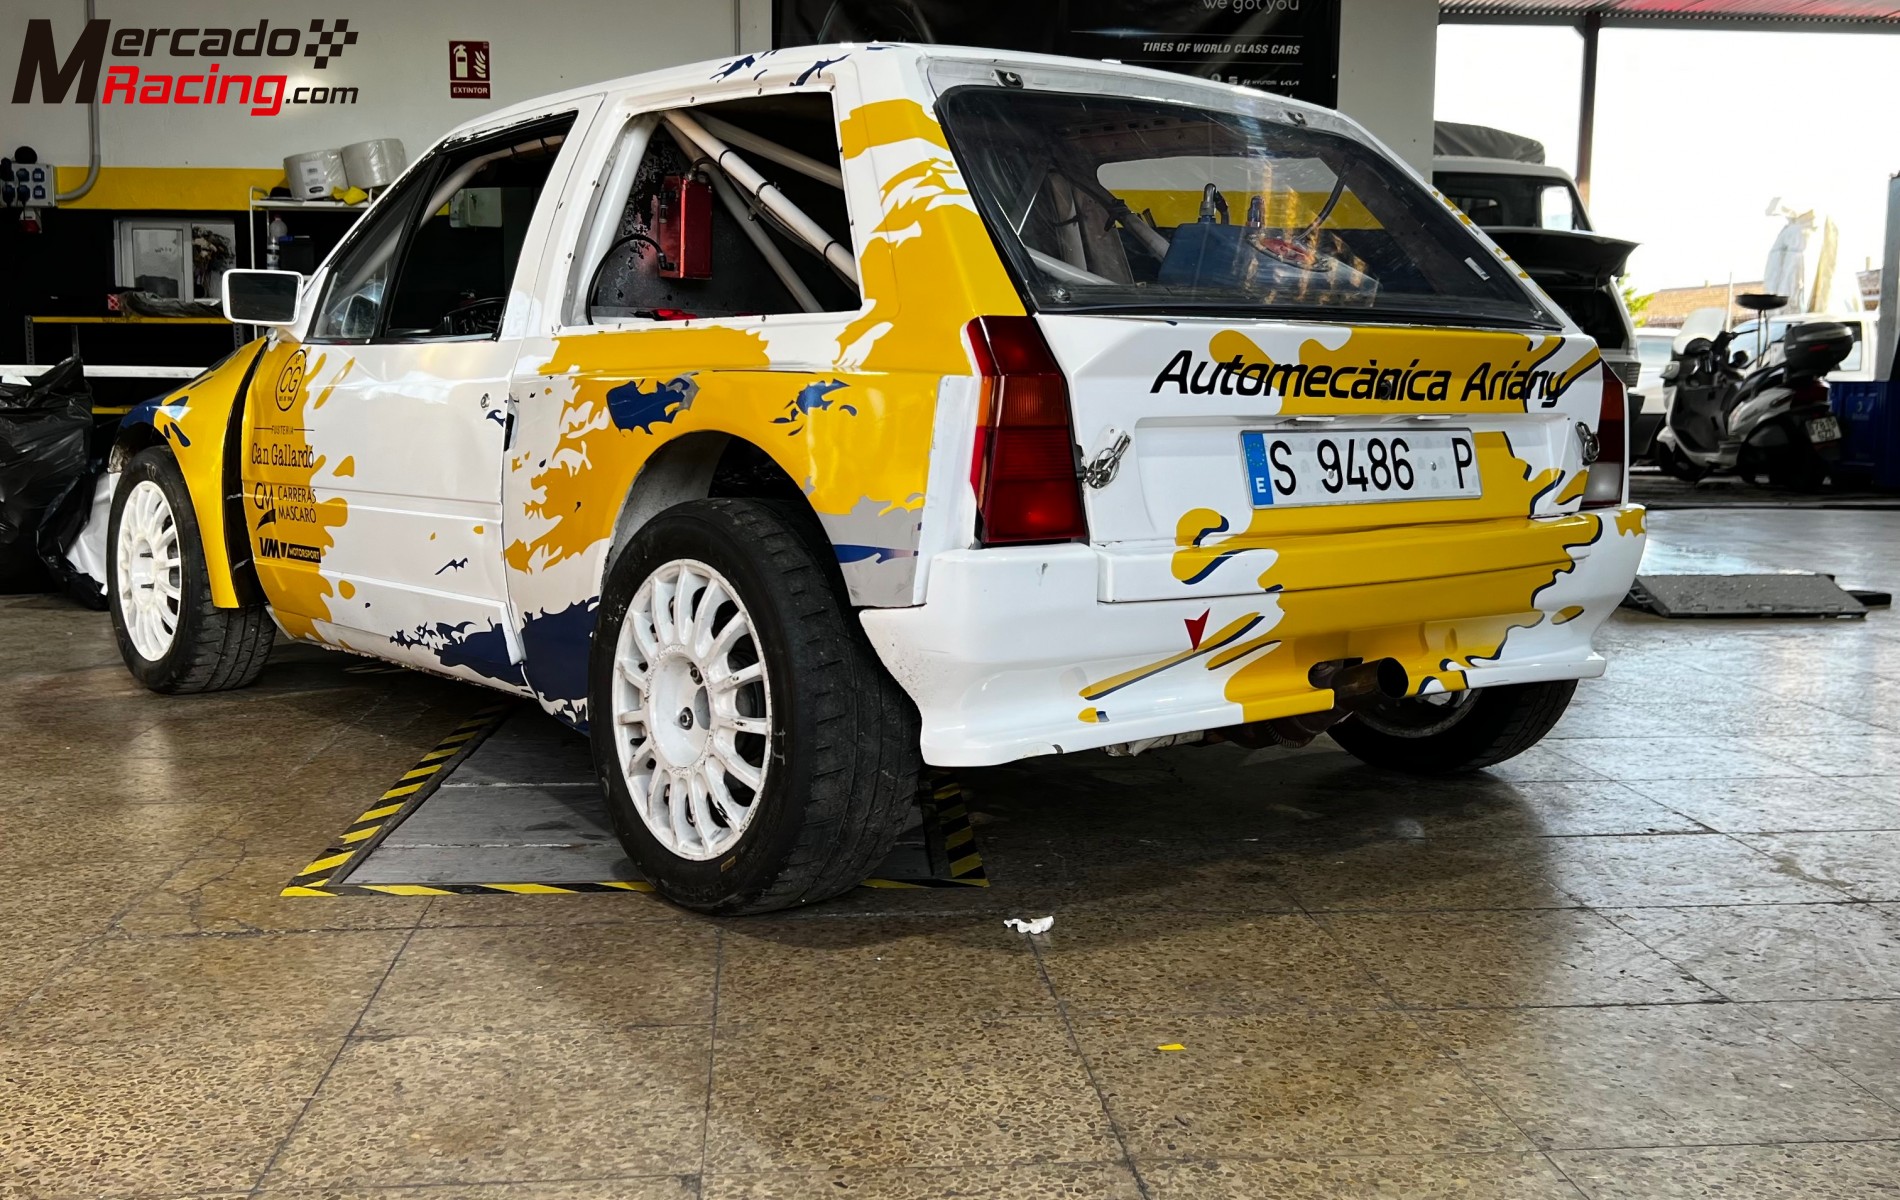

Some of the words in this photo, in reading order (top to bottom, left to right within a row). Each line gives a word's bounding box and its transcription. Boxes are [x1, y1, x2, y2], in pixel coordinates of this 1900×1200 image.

[1203, 0, 1227, 9] we
[1233, 0, 1262, 14] got
[1266, 0, 1299, 14] you
[1143, 42, 1174, 52] TIRES
[1176, 43, 1191, 52] OF
[1193, 43, 1232, 53] WORLD
[1234, 44, 1269, 54] CLASS
[1271, 45, 1301, 55] CARS
[453, 86, 488, 94] EXTINTOR
[280, 366, 301, 393] CG
[271, 425, 294, 436] FUSTERIA
[251, 442, 270, 465] Can
[1269, 440, 1297, 496] S
[1316, 437, 1415, 494] 9486
[1451, 437, 1473, 489] P
[1255, 477, 1267, 493] E
[277, 485, 317, 504] CARRERAS
[288, 546, 321, 560] MOTORSPORT
